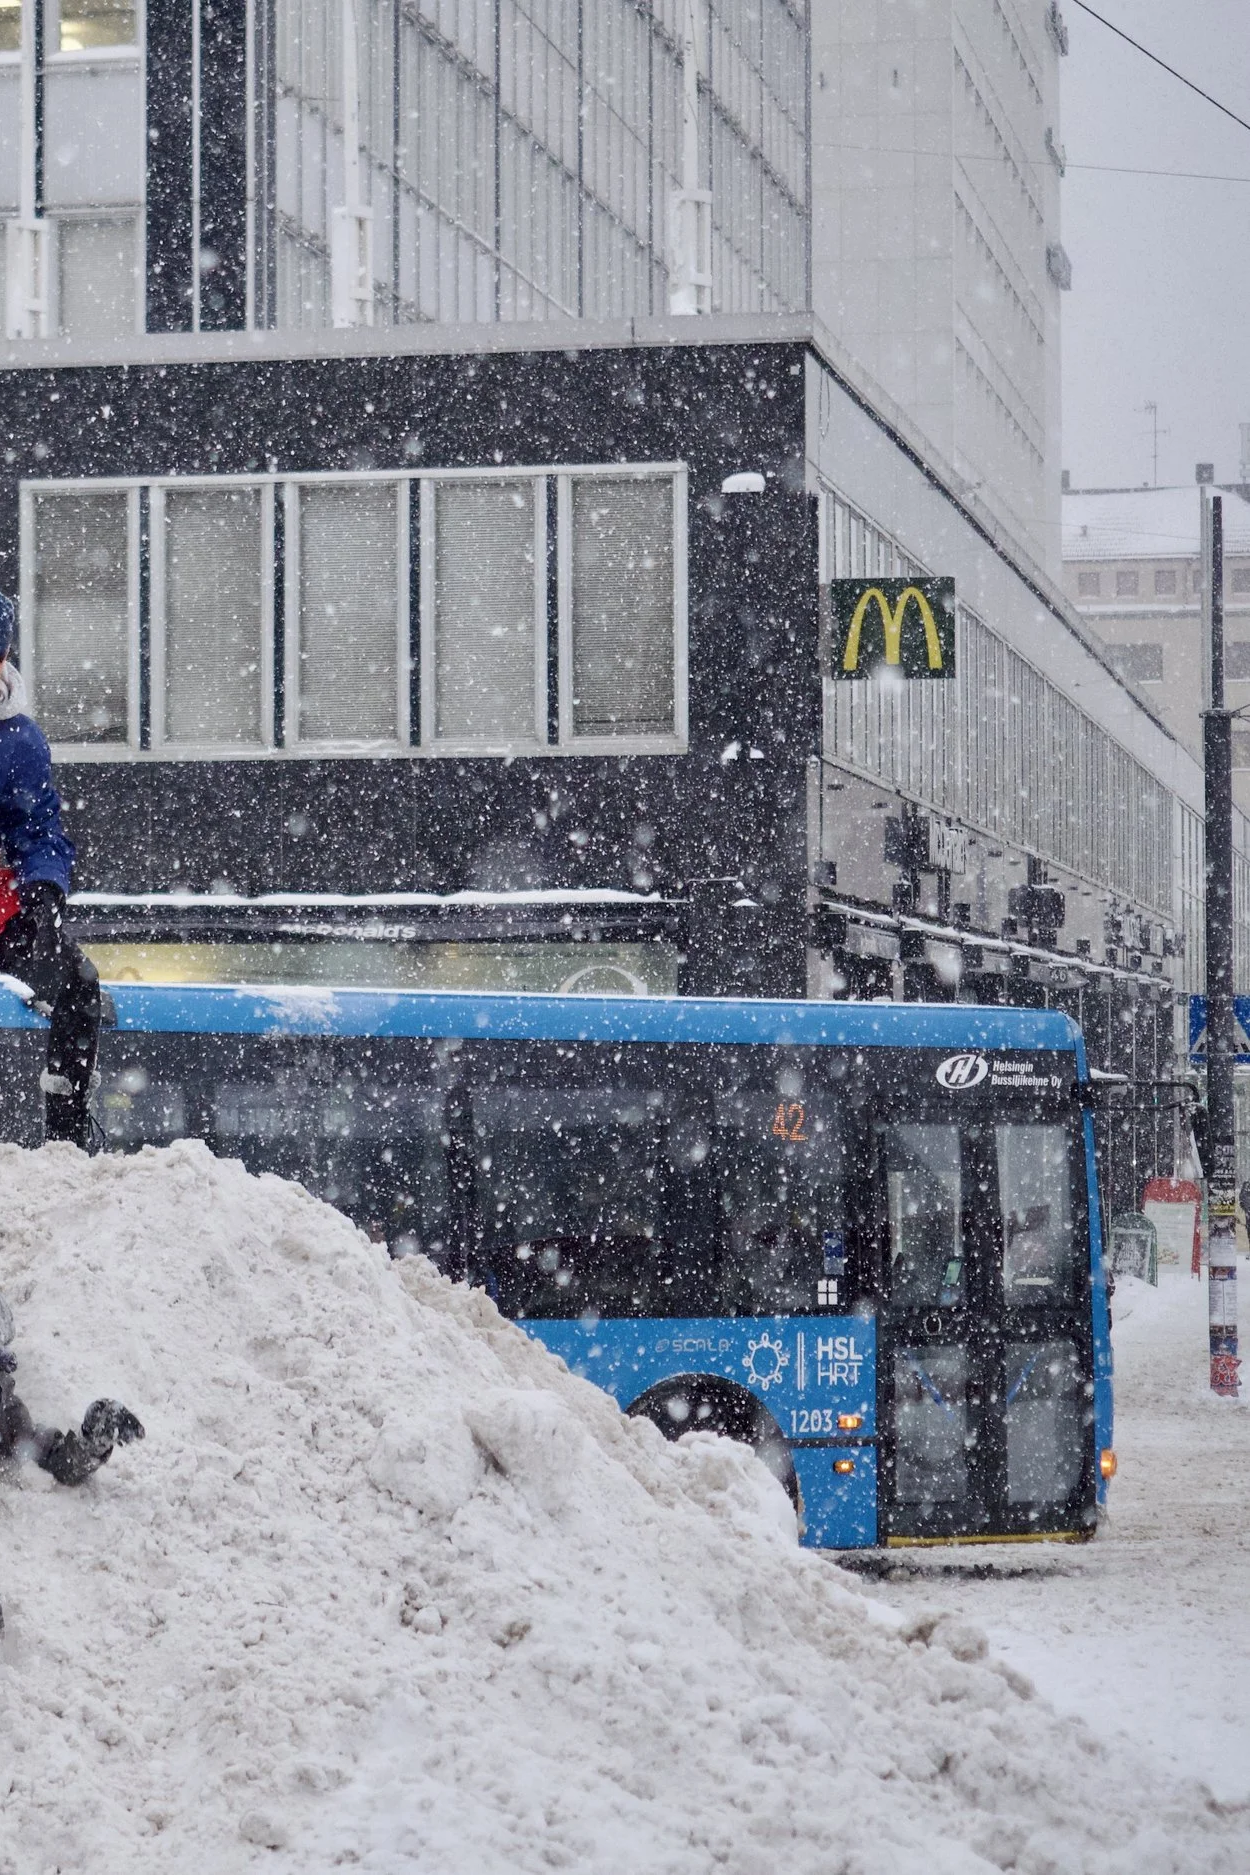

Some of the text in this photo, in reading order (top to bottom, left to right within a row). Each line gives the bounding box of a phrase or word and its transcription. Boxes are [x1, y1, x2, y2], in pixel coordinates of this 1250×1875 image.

[992, 1060, 1034, 1073] Helsingin
[991, 1074, 1063, 1089] Bussiliikenne Oy
[772, 1103, 809, 1141] 42
[817, 1336, 863, 1361] HSL
[817, 1362, 863, 1387] HRT
[791, 1409, 833, 1433] 1203
